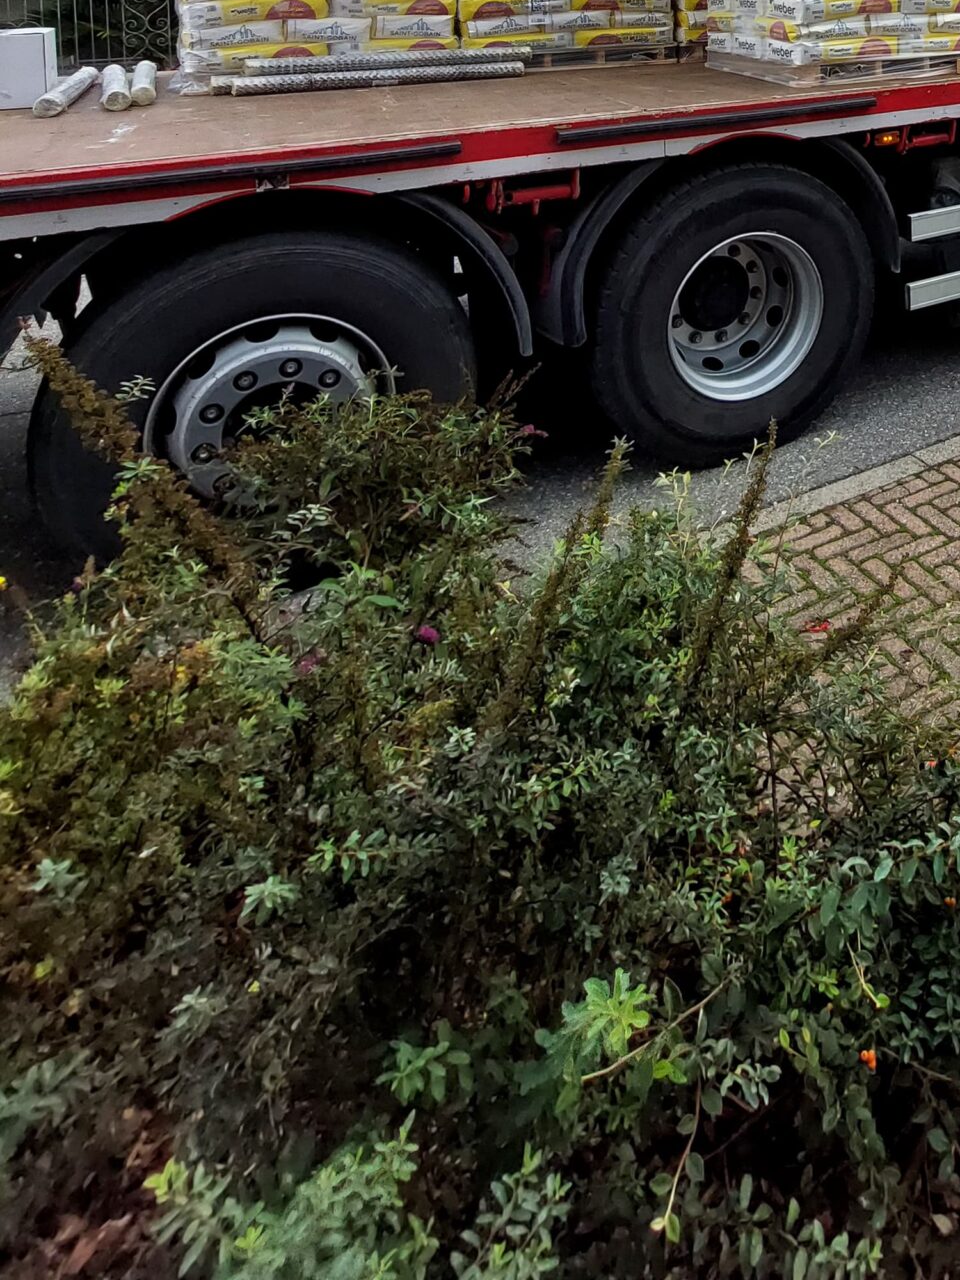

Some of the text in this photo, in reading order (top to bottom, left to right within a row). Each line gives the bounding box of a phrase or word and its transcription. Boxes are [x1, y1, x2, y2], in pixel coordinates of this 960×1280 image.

[740, 0, 757, 9] weber
[773, 1, 796, 15] weber
[738, 41, 756, 51] weber
[771, 45, 794, 58] weber
